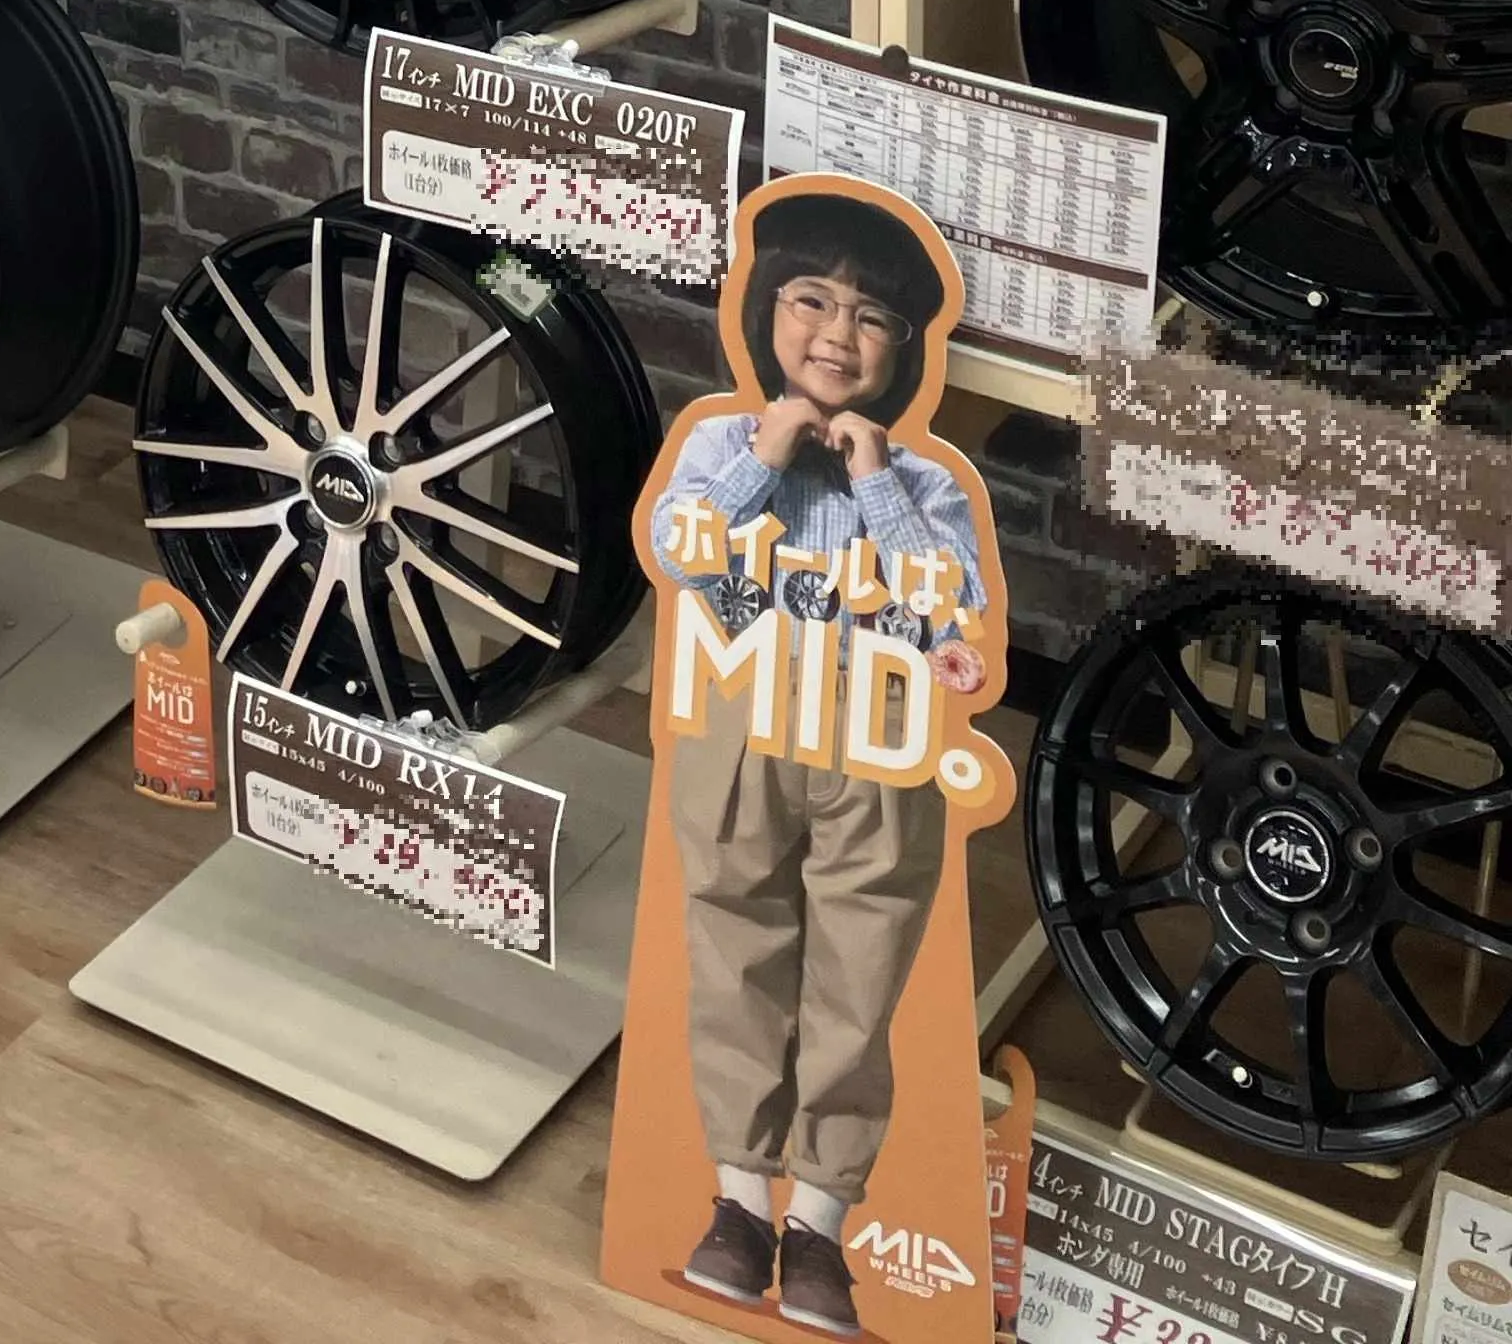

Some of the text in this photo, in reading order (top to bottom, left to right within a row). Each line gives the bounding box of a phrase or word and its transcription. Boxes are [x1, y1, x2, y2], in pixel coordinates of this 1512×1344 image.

[452, 64, 516, 108] MID
[525, 80, 595, 126] EXC
[616, 101, 698, 149] 020F
[315, 472, 365, 504] MID
[147, 683, 194, 725] MID
[304, 712, 383, 771] MID
[1093, 1175, 1157, 1227] MID
[848, 1221, 977, 1287] MID
[868, 1256, 952, 1295] WHEELS
[1057, 1231, 1145, 1289] ホンダ専用
